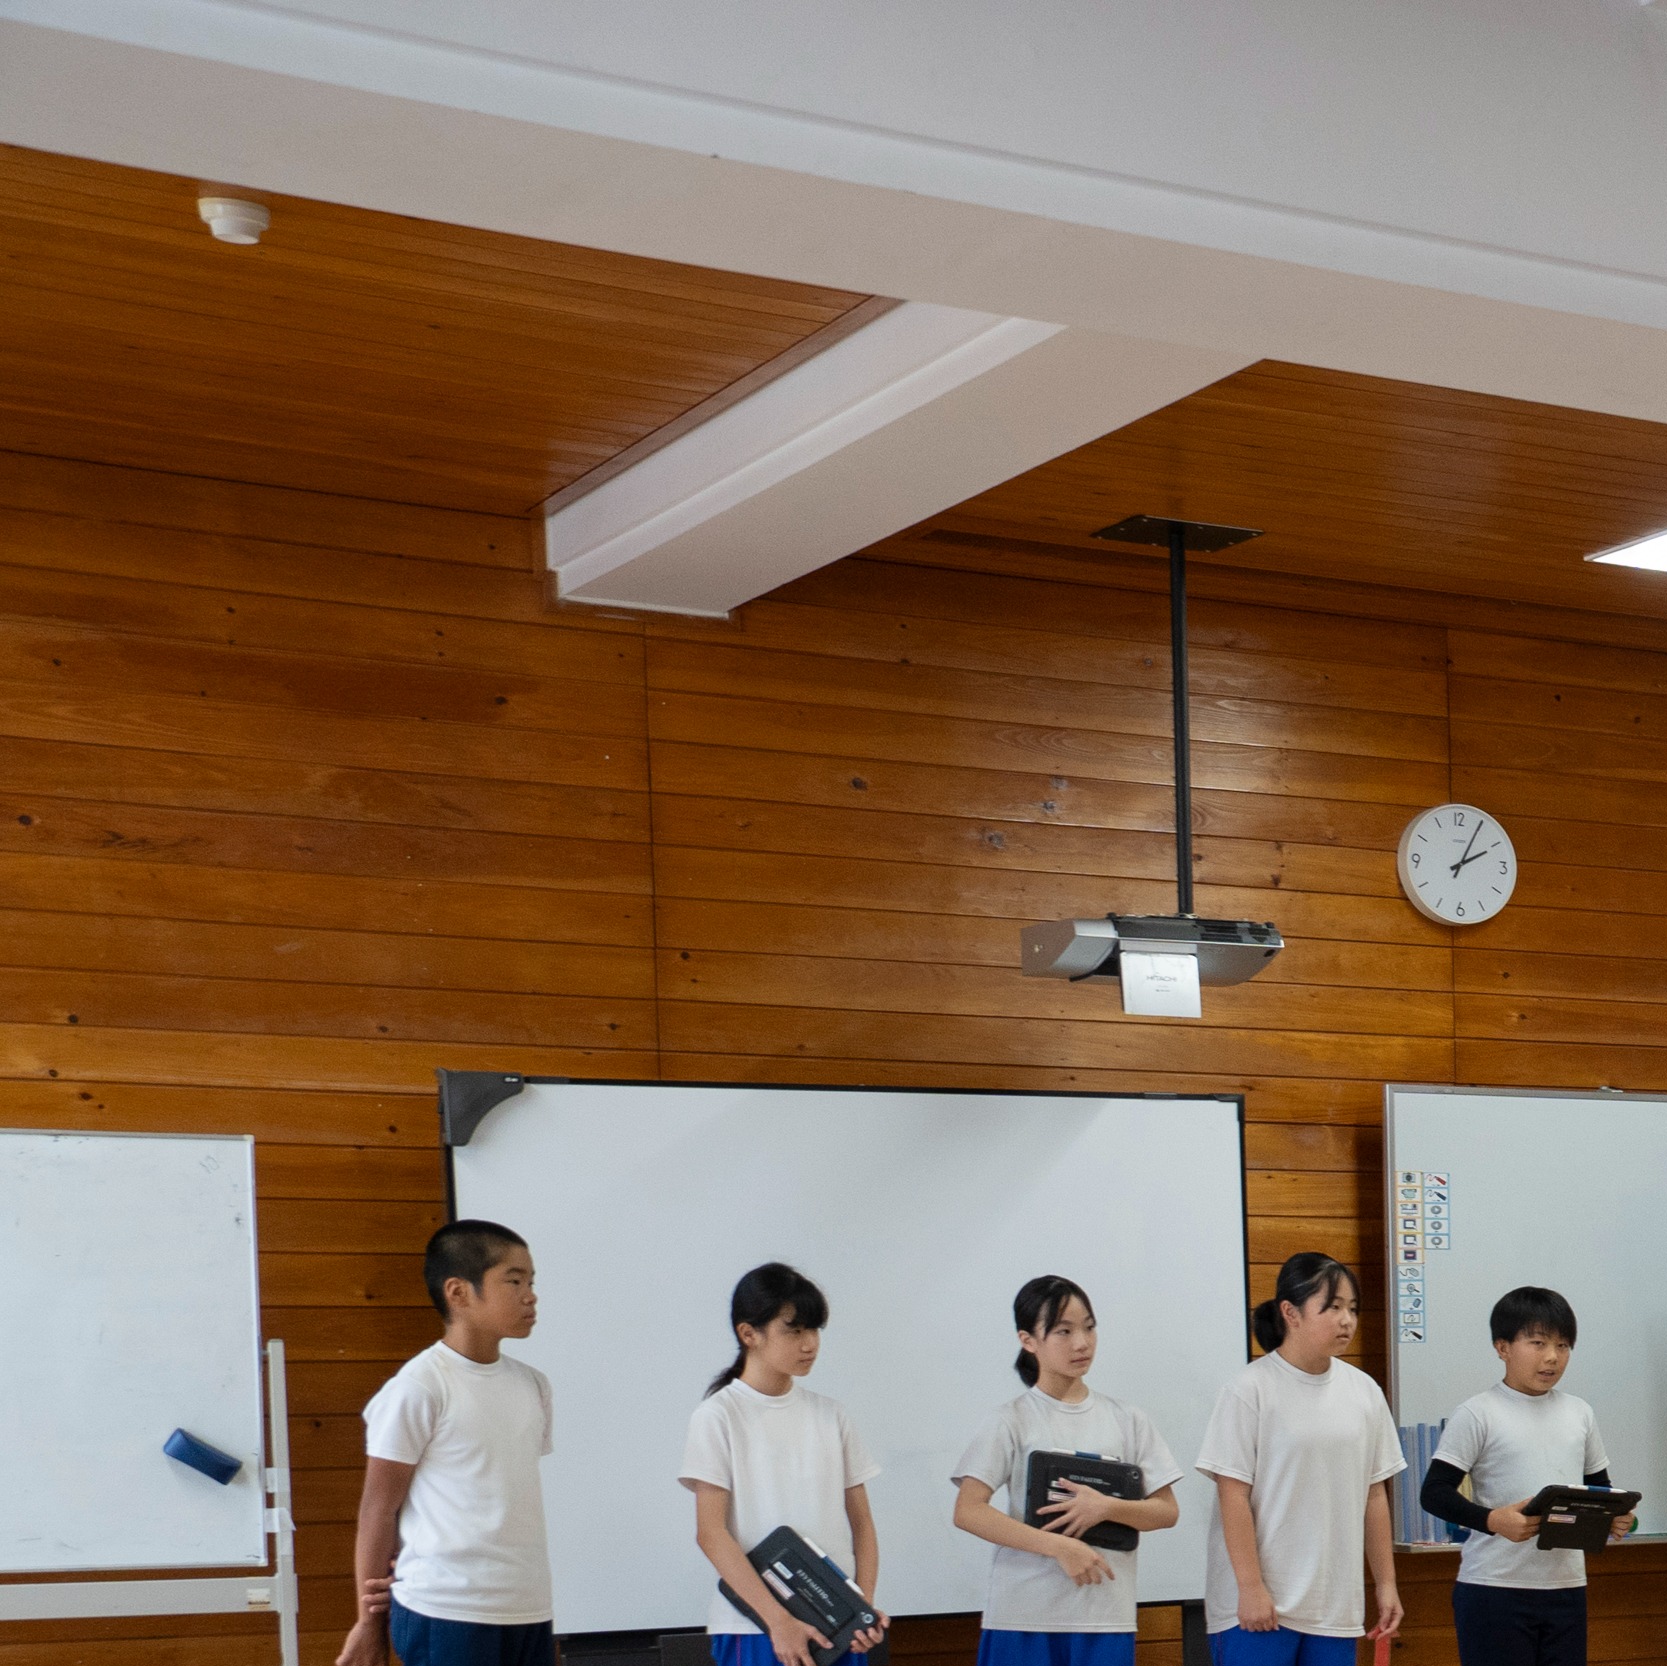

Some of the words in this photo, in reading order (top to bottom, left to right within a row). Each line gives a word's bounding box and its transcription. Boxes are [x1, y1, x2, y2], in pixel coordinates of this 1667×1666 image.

[1454, 812, 1465, 826] 12
[1411, 853, 1421, 869] 9
[1499, 861, 1508, 875] 3
[1456, 902, 1466, 917] 6
